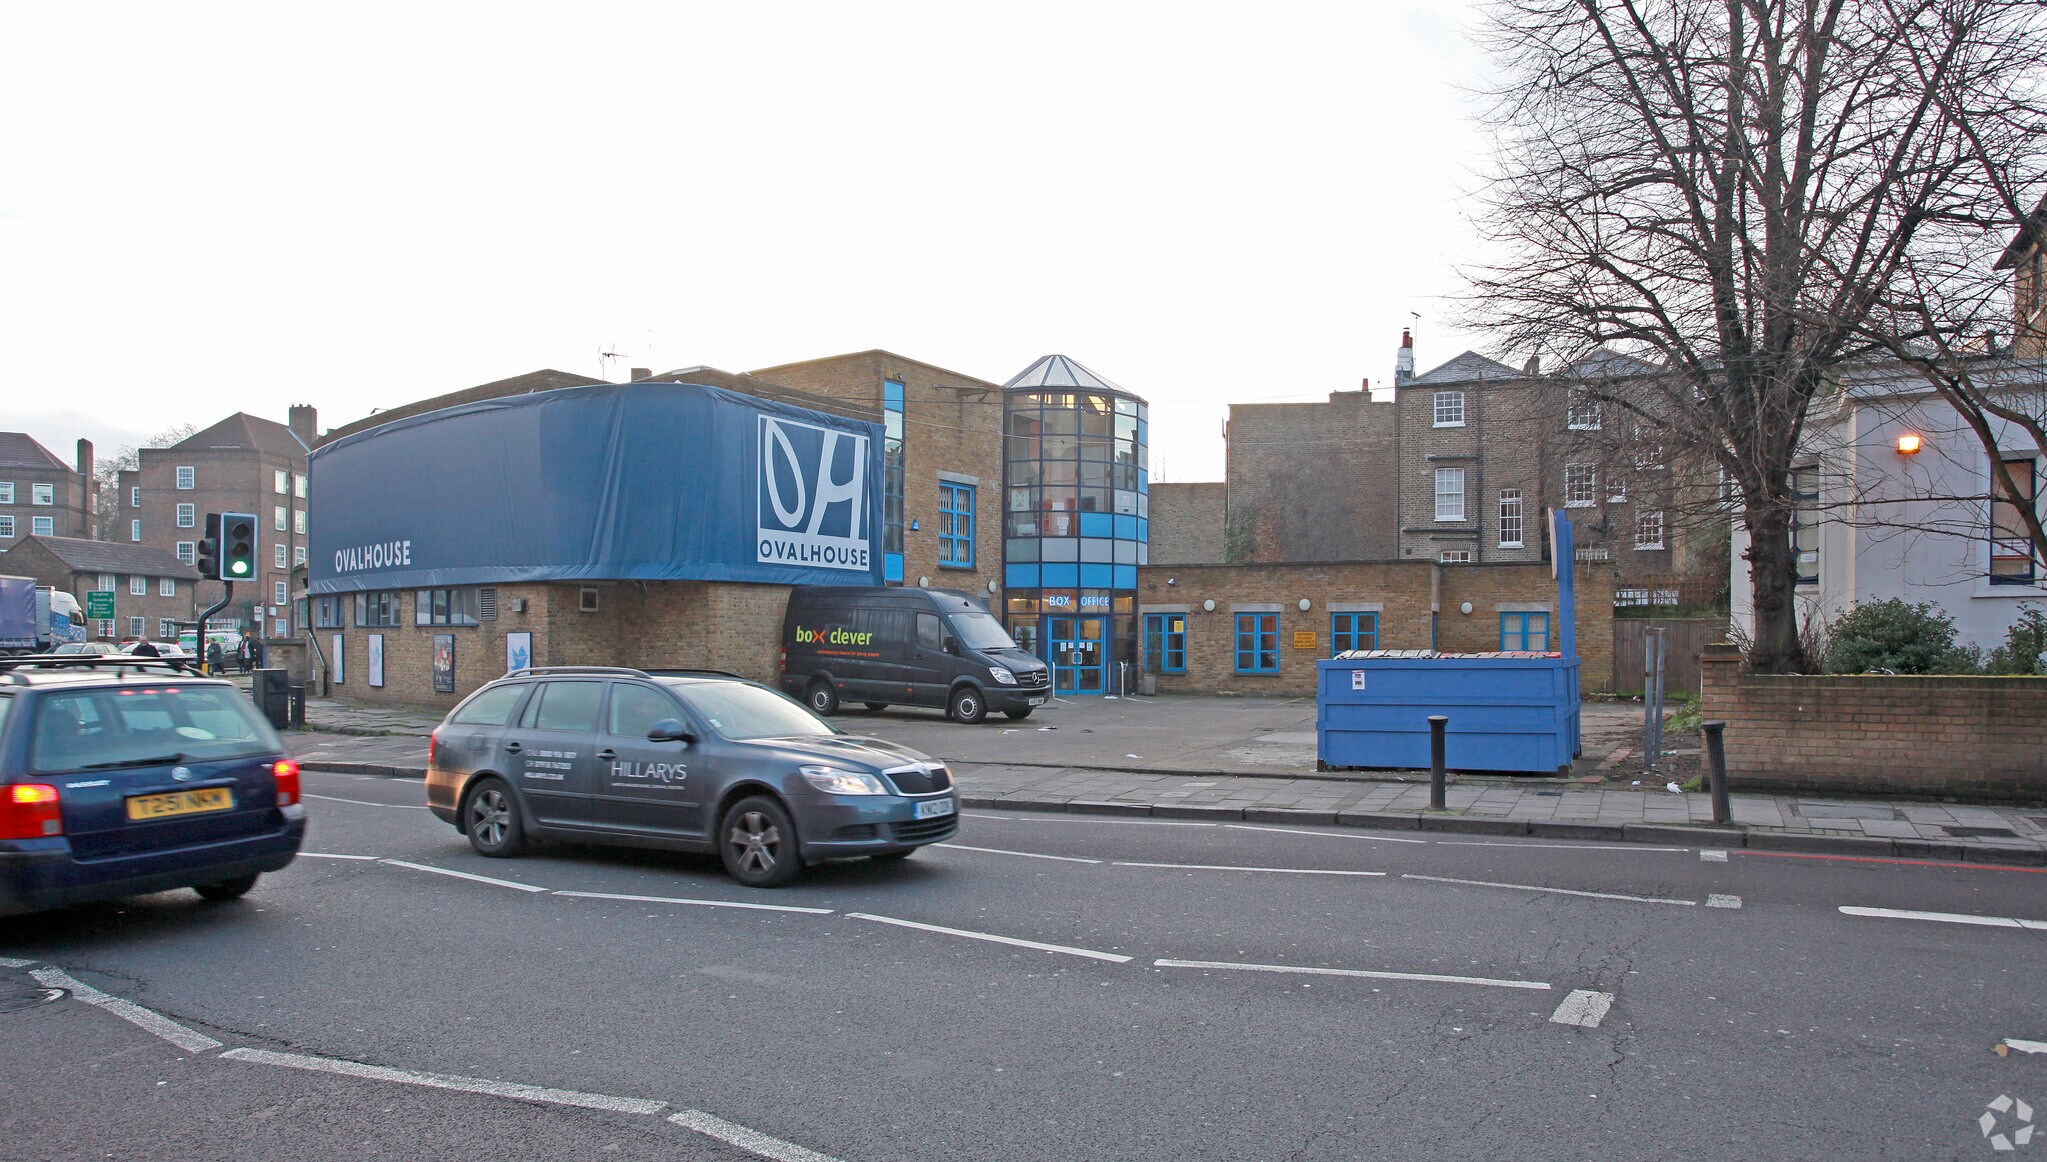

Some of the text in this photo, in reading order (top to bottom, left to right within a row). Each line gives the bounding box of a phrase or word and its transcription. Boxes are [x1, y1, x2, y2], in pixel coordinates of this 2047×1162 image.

[335, 540, 411, 573] OVALHOUSE
[759, 539, 868, 567] OVALHOUSE
[1049, 596, 1109, 606] BOX OFFICE
[796, 625, 873, 646] box clever
[611, 761, 688, 783] HILLARYS
